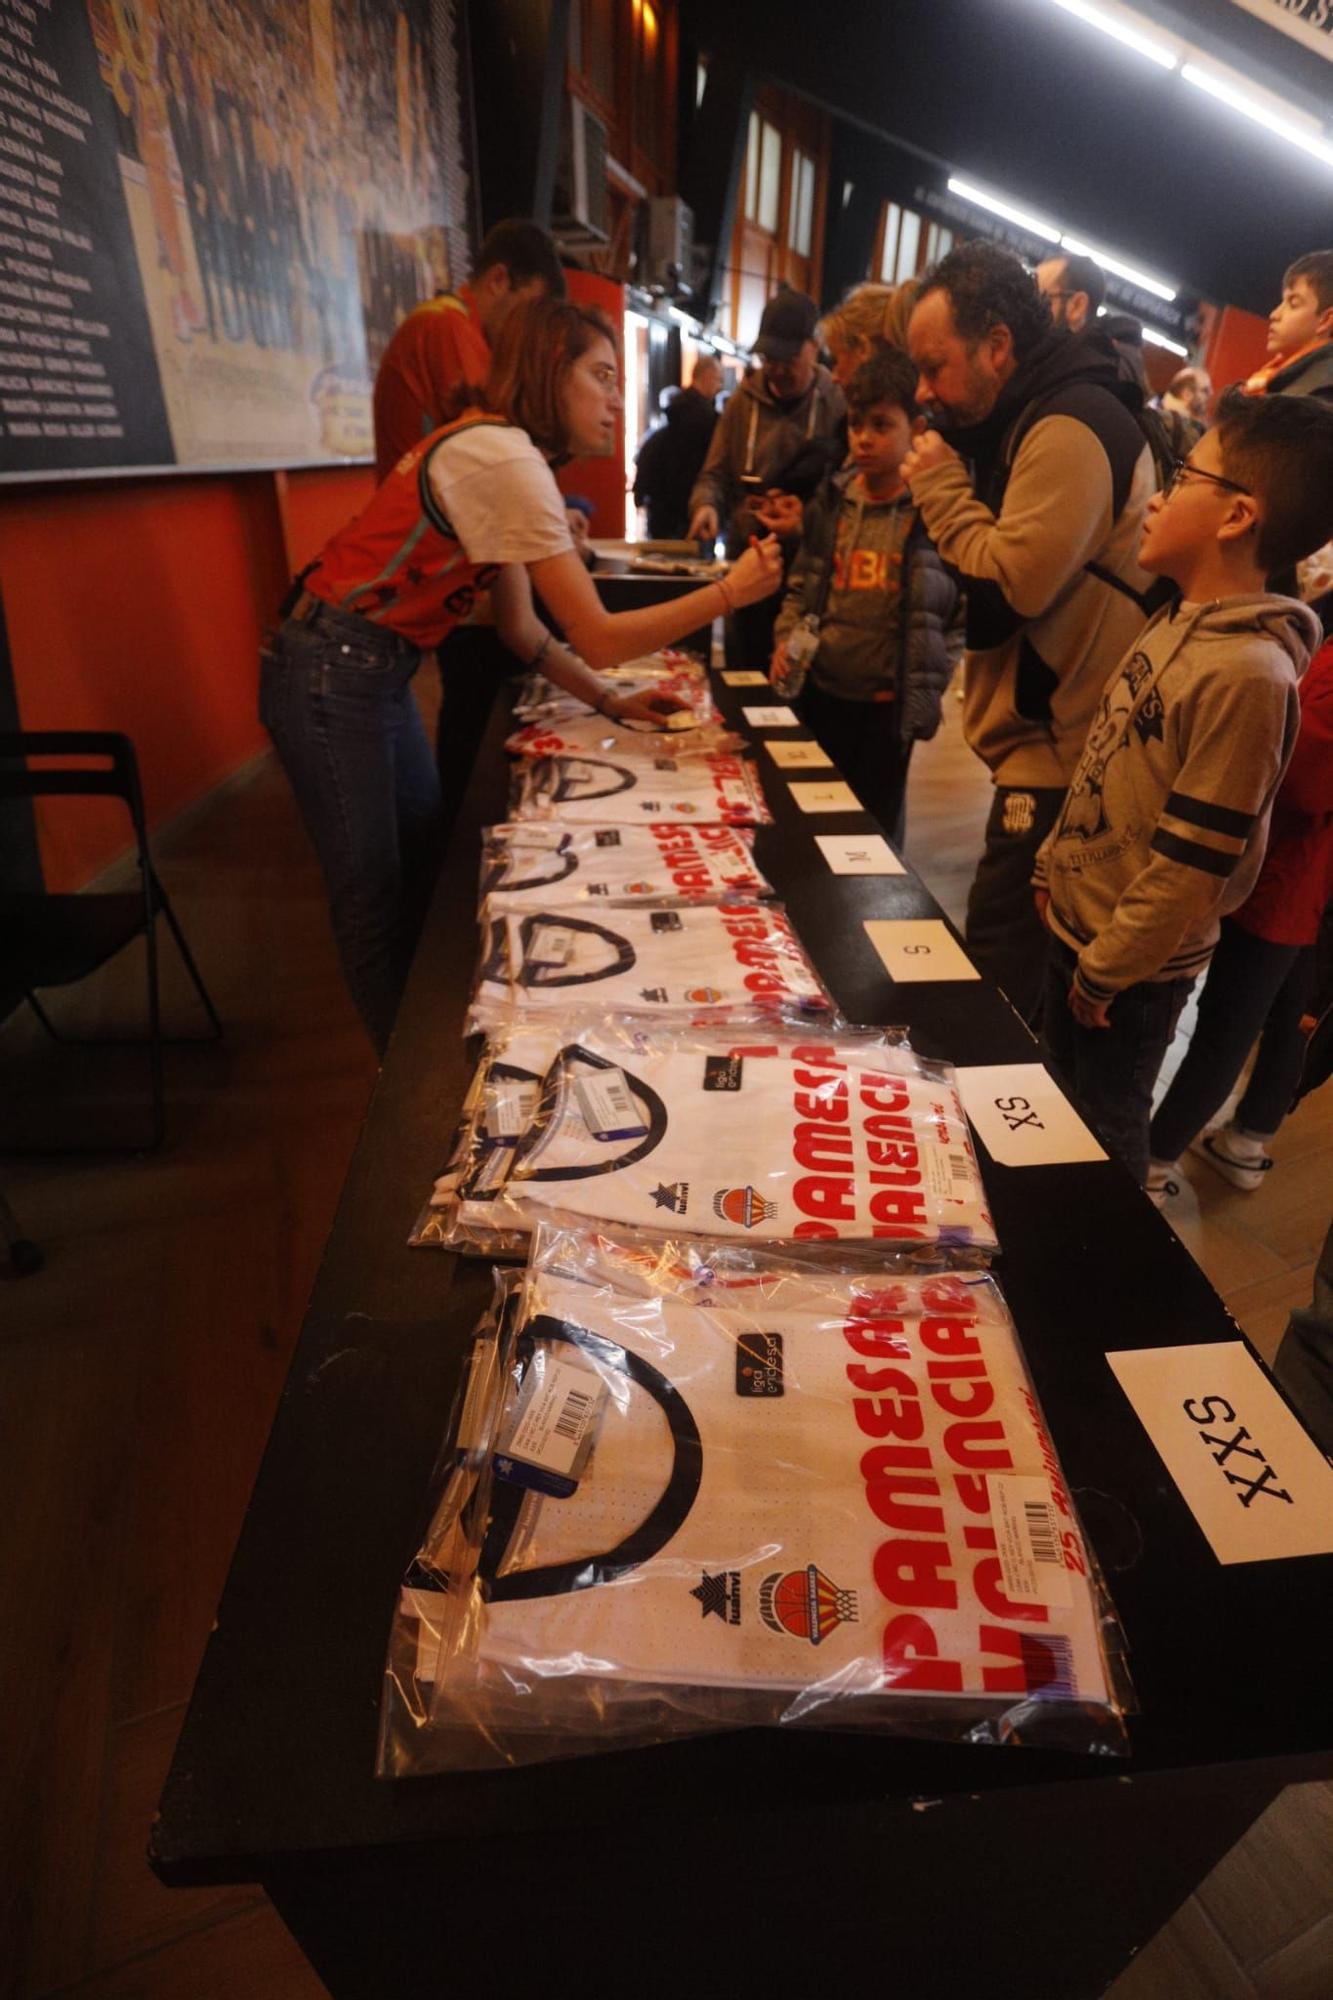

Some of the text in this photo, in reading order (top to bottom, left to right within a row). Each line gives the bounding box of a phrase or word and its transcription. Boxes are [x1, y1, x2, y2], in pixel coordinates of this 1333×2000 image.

[844, 850, 872, 863] M
[903, 944, 932, 956] S
[994, 1094, 1045, 1132] XS
[750, 1372, 764, 1397] liga
[765, 1335, 779, 1397] endesa
[1184, 1394, 1292, 1508] XXS
[843, 1300, 963, 1692] PAMESA
[1060, 1530, 1089, 1577] 25
[729, 1569, 742, 1626] luanvi
